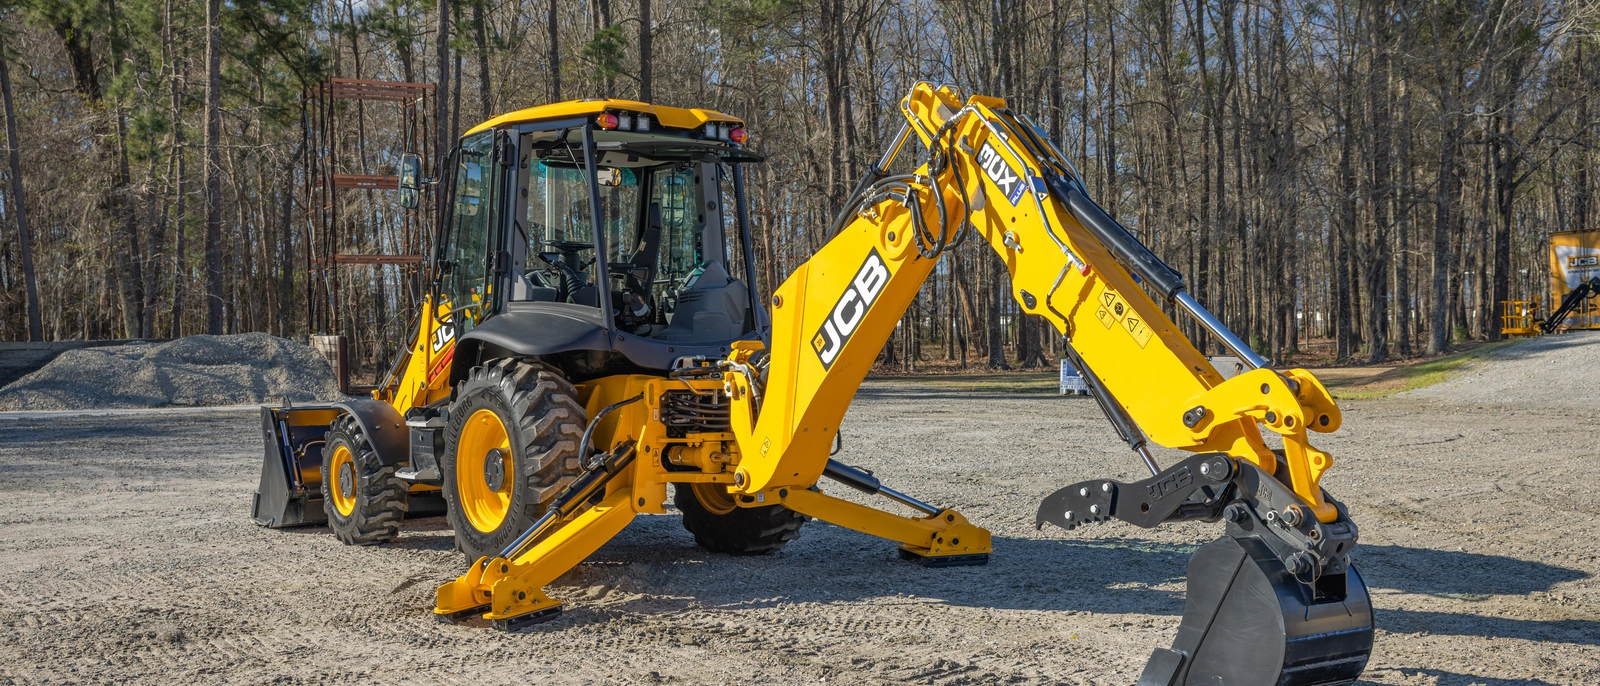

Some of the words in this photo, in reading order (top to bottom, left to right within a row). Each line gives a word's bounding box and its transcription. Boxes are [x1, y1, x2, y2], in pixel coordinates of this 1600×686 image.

[1011, 183, 1026, 205] PLUS
[1569, 256, 1597, 266] JCB
[820, 255, 887, 364] JCB
[434, 319, 455, 352] JC
[1147, 466, 1194, 497] JCB
[1257, 480, 1272, 501] JCB
